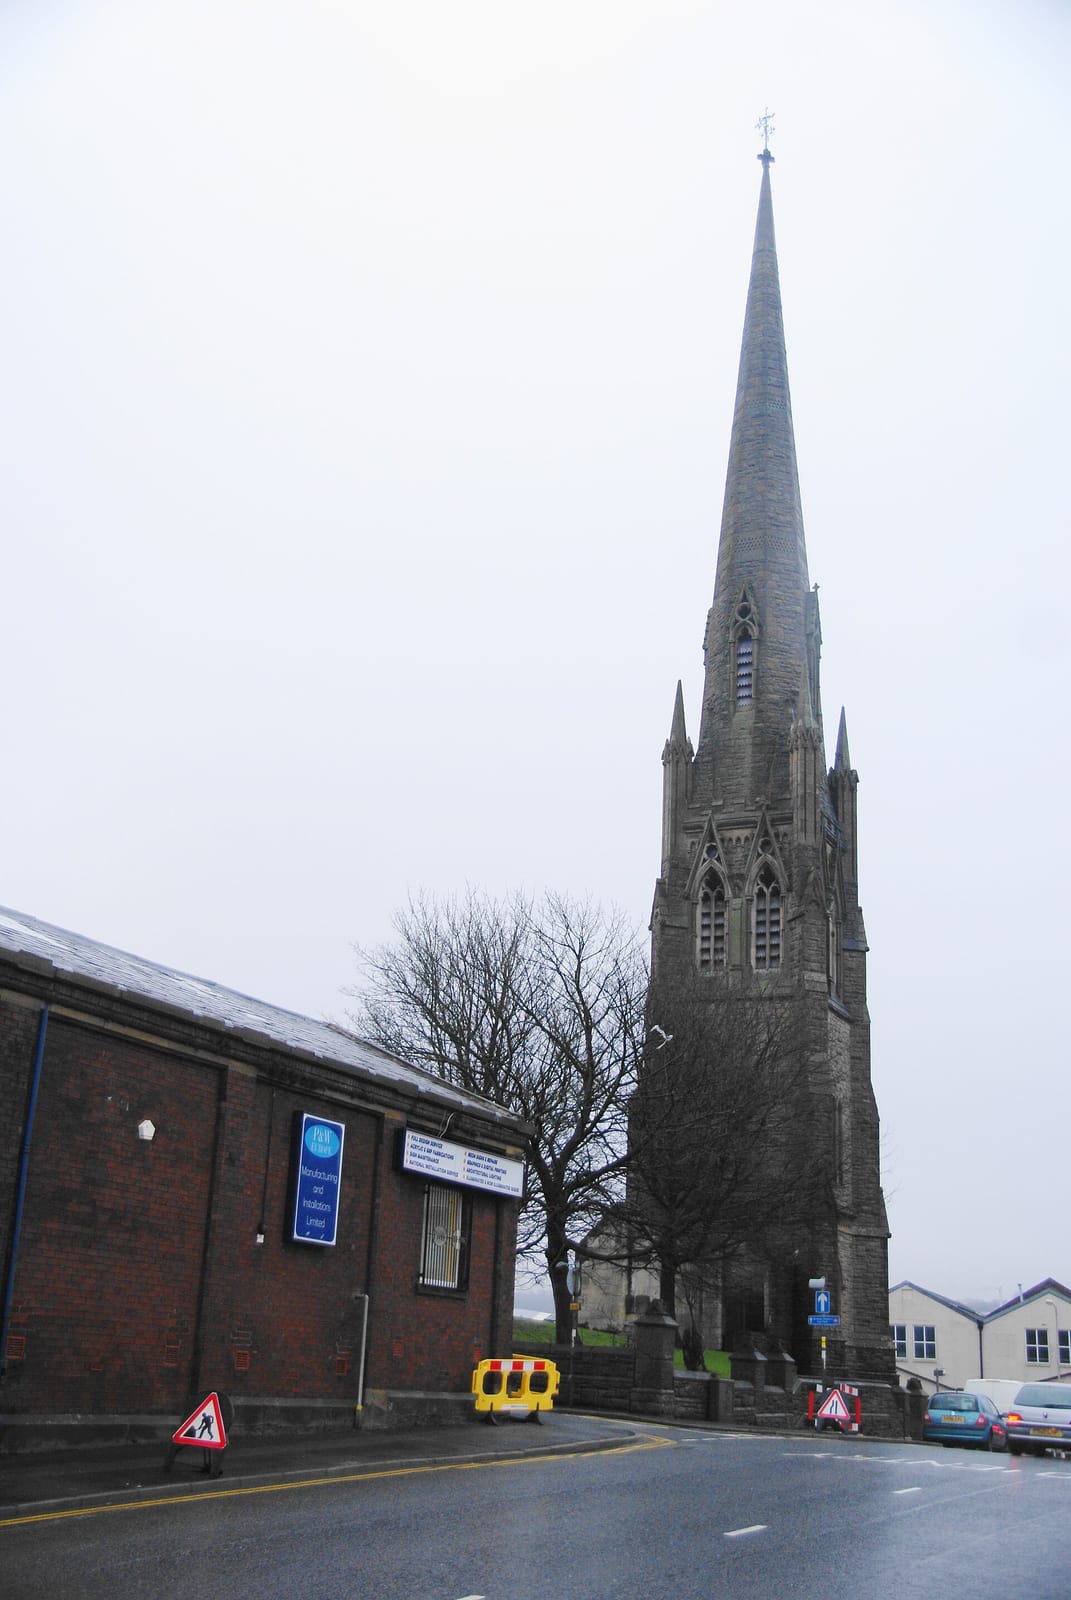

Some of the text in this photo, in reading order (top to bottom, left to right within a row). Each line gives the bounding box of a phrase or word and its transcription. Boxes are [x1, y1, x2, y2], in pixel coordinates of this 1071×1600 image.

[302, 1165, 338, 1184] Manufacturing
[312, 1185, 324, 1194] and
[303, 1197, 331, 1212] Installations
[306, 1216, 326, 1228] Limited
